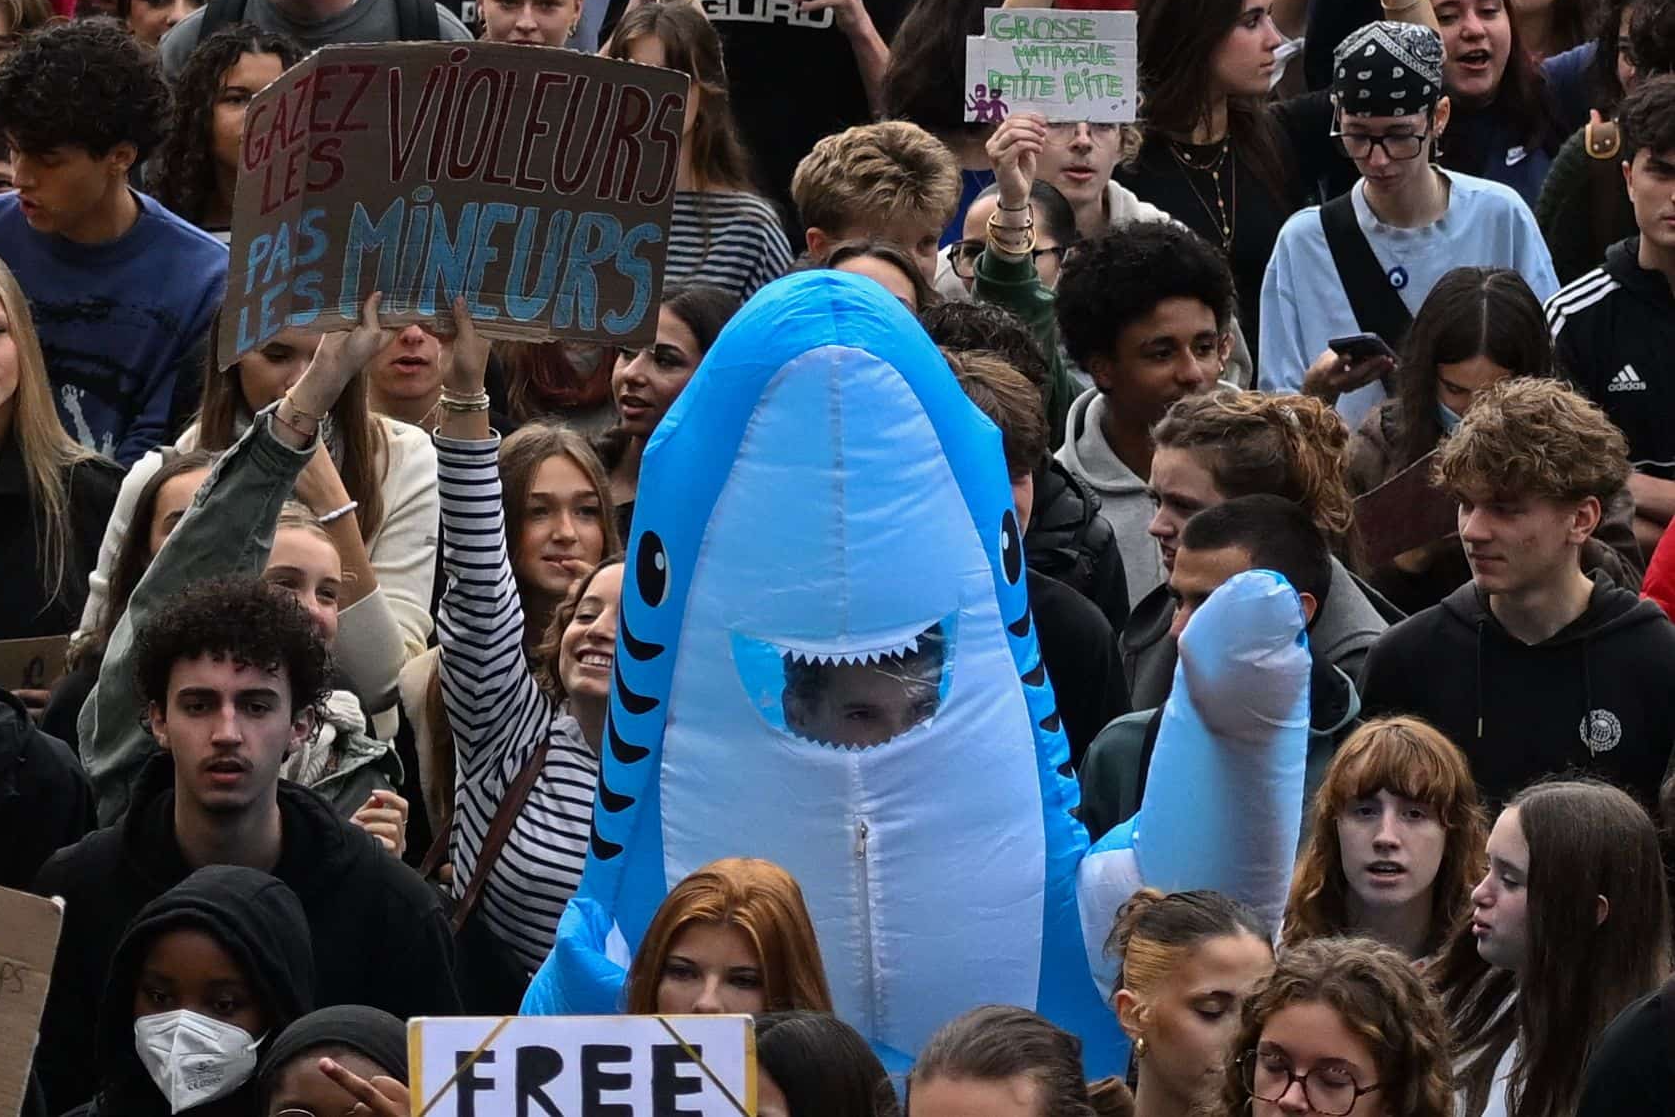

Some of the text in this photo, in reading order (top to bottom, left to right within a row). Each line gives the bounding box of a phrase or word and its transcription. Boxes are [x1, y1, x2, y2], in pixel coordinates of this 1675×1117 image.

[989, 12, 1097, 43] GROSSE
[242, 64, 381, 175] GAZEZ
[259, 135, 345, 217] LES
[244, 206, 330, 292] PAS
[234, 269, 326, 354] LES
[454, 1043, 706, 1117] FREE
